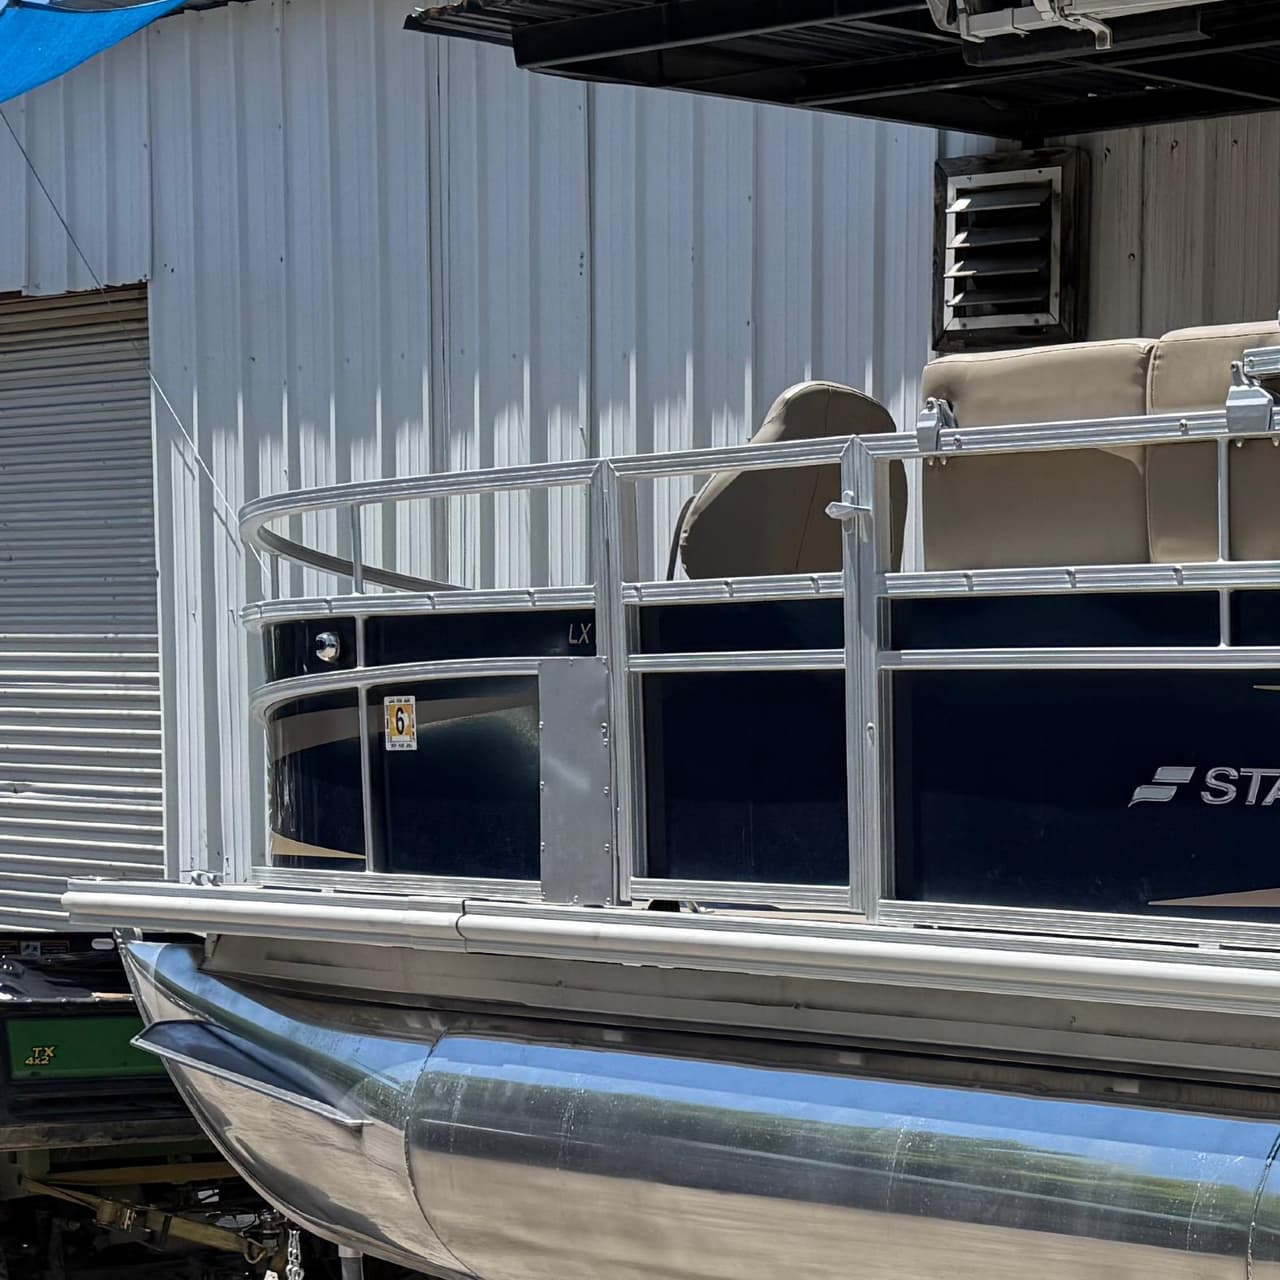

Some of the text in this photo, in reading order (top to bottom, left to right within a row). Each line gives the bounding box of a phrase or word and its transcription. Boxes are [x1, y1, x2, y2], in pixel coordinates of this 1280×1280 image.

[568, 623, 591, 644] LX
[396, 707, 404, 735] 6
[32, 1046, 55, 1057] TX
